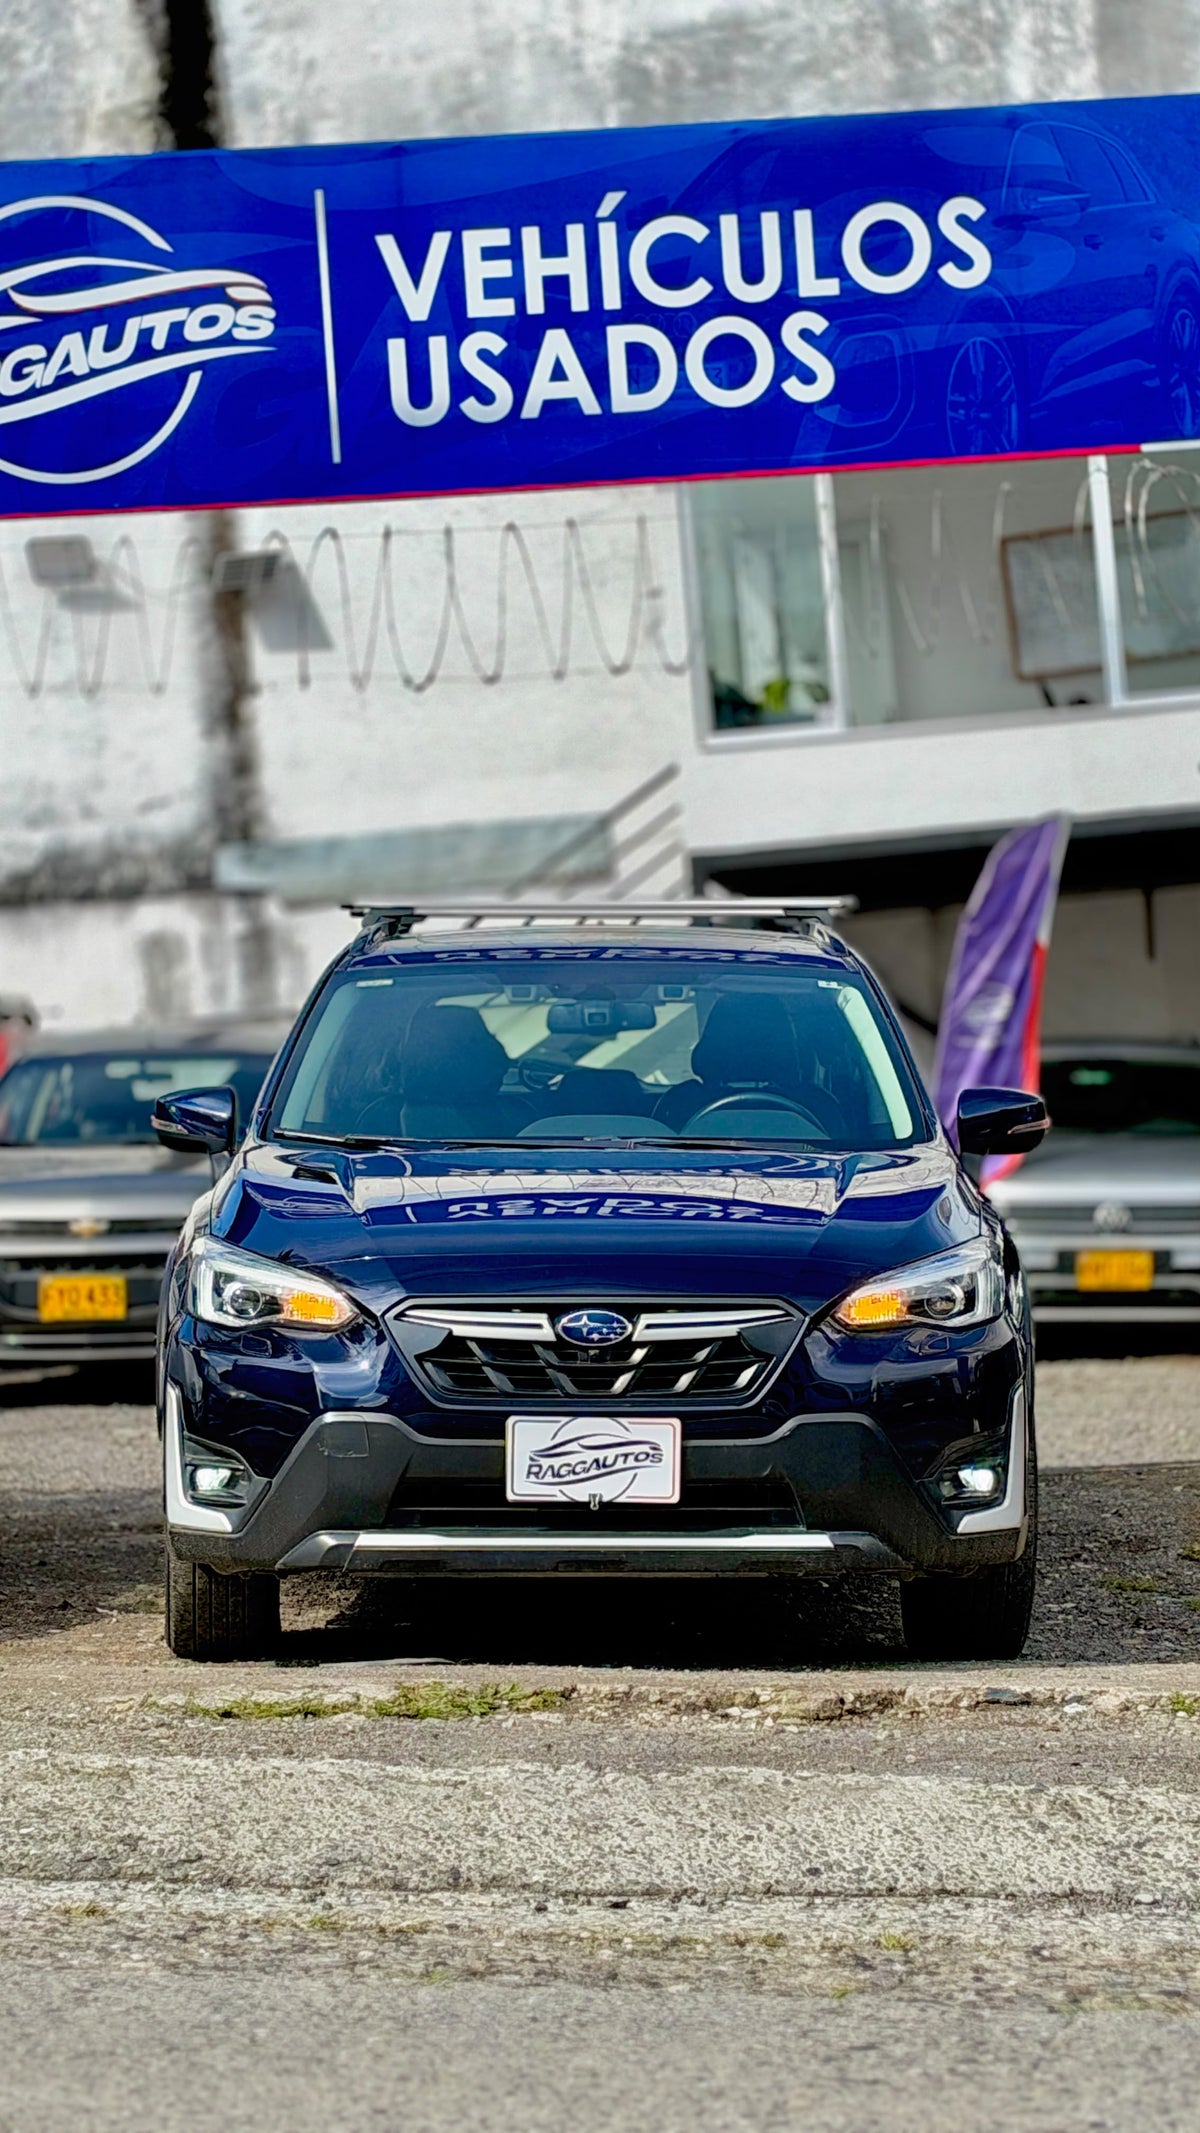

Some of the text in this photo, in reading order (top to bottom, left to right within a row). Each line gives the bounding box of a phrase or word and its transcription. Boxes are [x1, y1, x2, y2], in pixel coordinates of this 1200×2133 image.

[375, 191, 993, 322] VEHÍCULOS
[387, 310, 835, 428] USADOS
[526, 1451, 664, 1480] RAGGAUTOS
